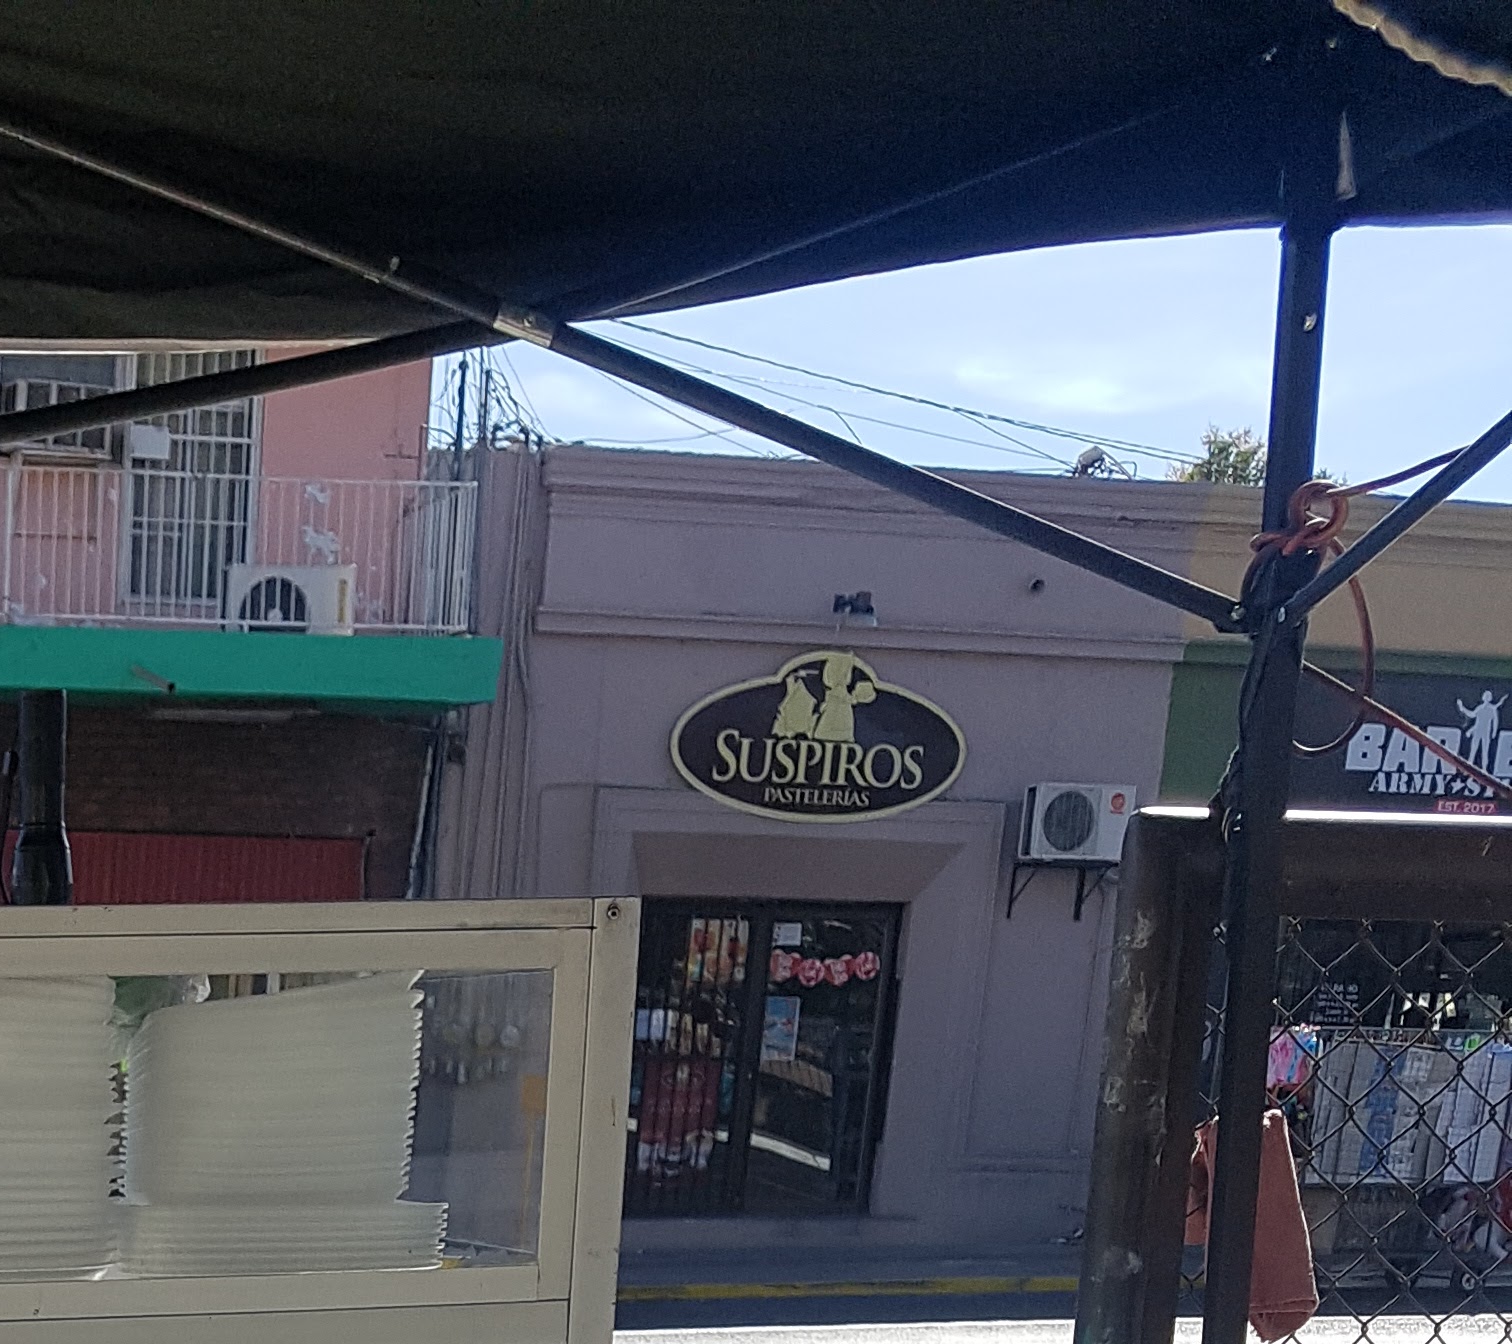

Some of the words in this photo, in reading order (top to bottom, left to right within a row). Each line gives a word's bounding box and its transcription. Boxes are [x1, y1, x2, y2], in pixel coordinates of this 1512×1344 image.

[712, 729, 924, 789] SUSPIROS
[1368, 771, 1451, 795] ARMY
[1438, 801, 1460, 813] EST.
[1464, 802, 1494, 813] 2017
